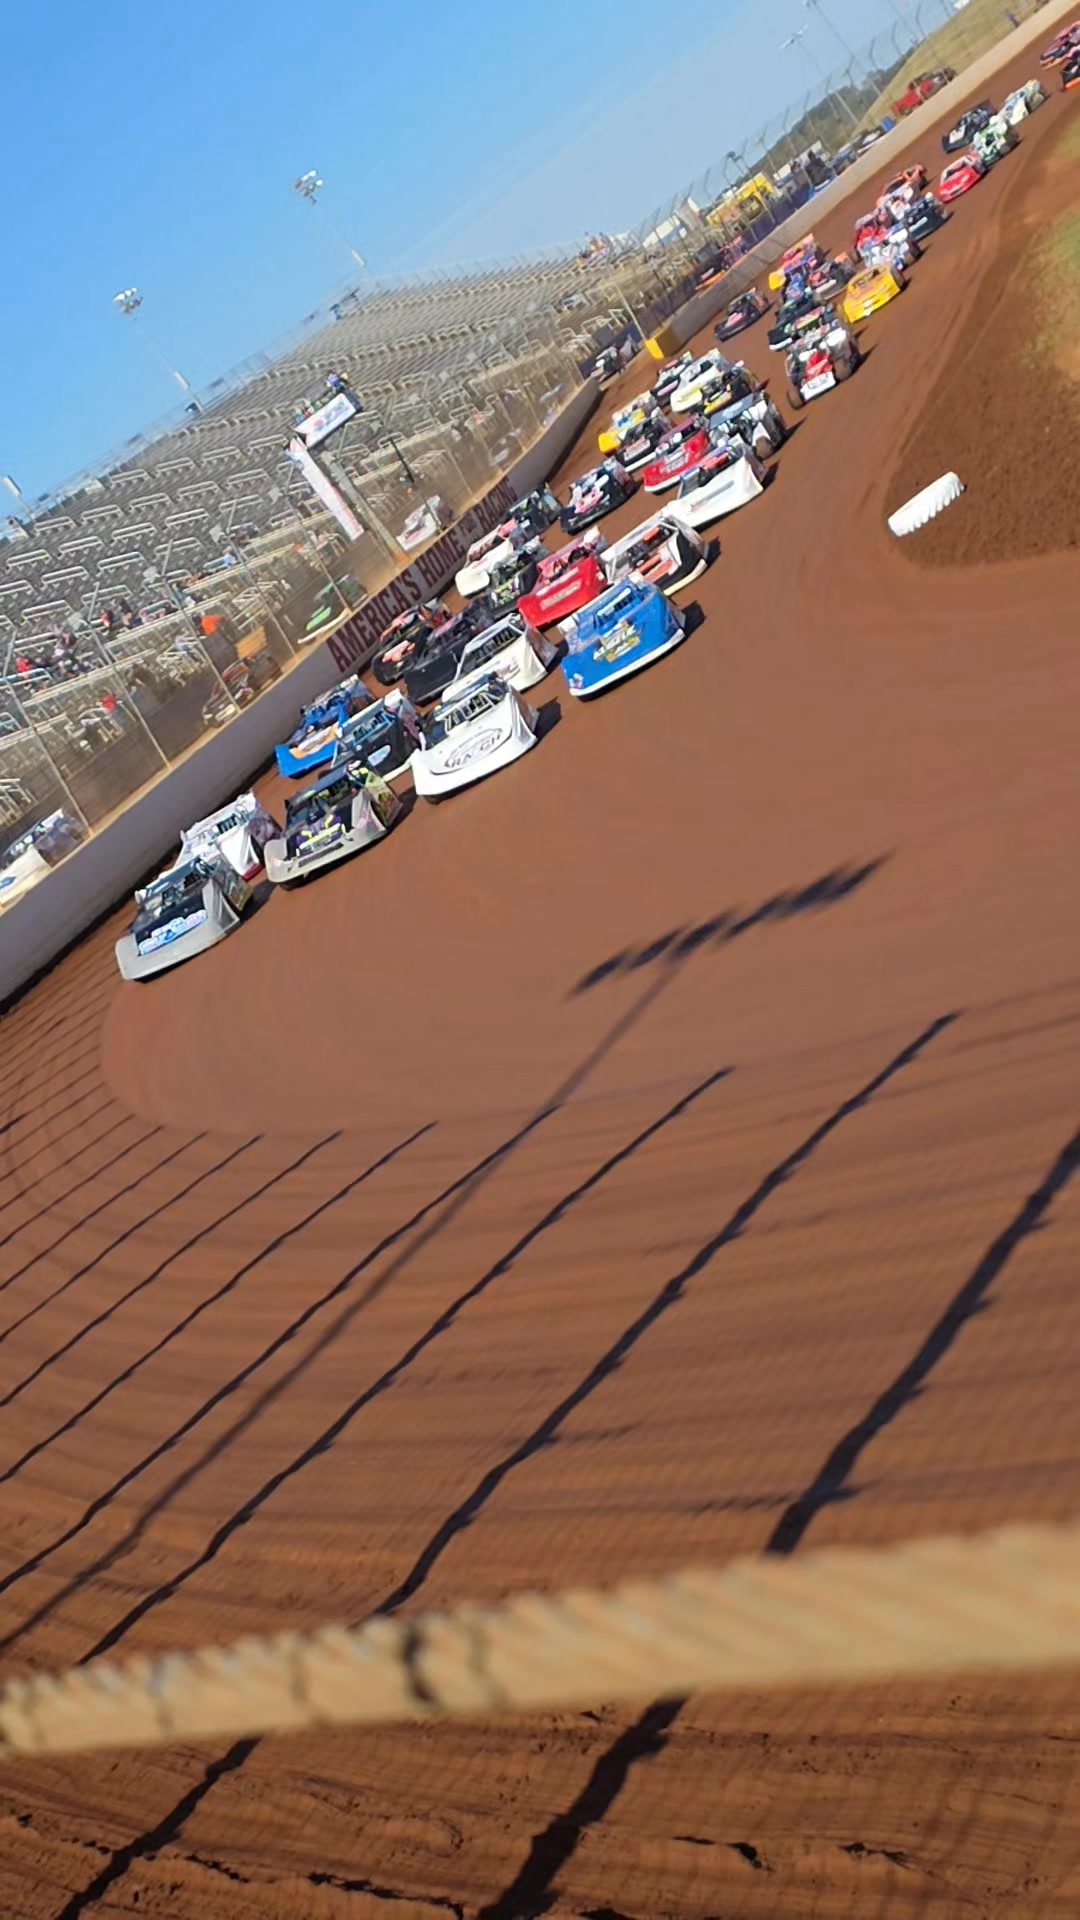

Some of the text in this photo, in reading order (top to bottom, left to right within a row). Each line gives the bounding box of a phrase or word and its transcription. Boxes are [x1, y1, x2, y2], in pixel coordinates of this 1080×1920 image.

[326, 571, 422, 672] AMERICA'S
[414, 528, 466, 588] HOME
[472, 477, 518, 534] RACING
